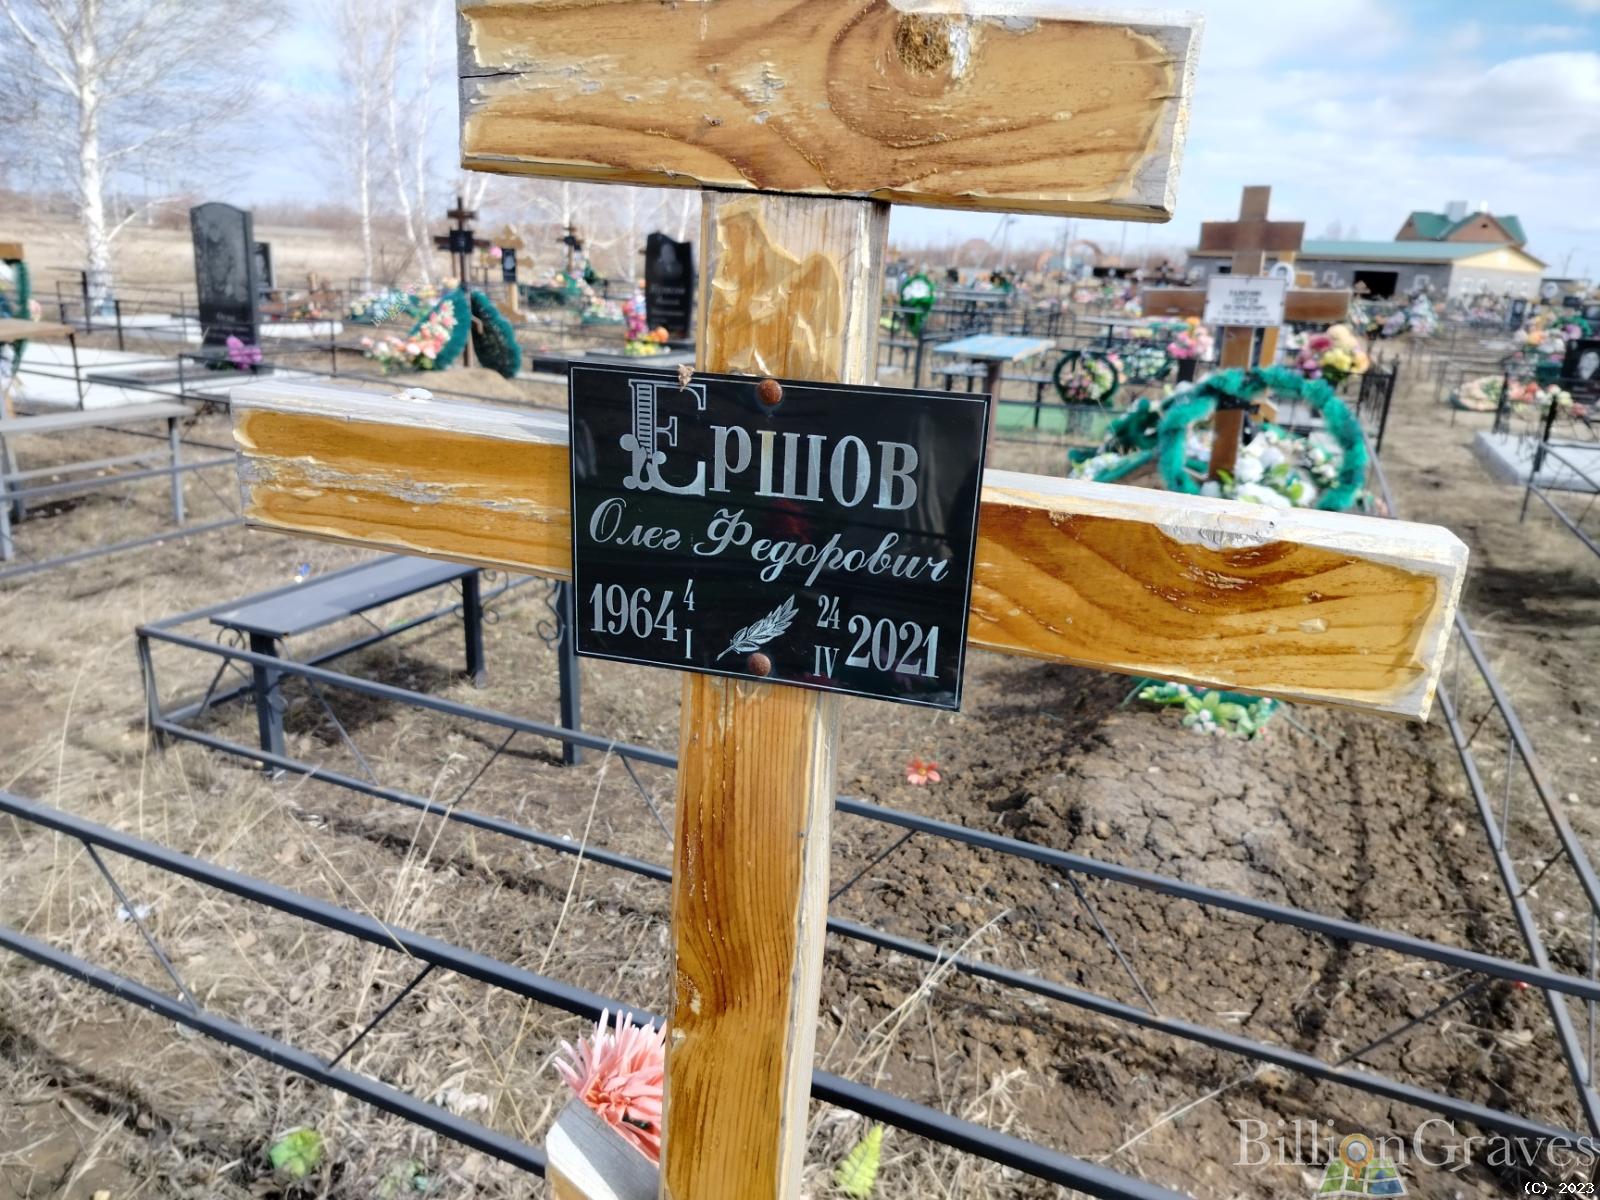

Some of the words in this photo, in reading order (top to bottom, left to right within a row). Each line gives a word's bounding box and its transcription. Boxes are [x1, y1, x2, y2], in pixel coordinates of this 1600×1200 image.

[589, 497, 682, 551] Олег
[693, 508, 949, 587] Федорович
[588, 583, 678, 642] 1964
[683, 579, 695, 611] 4
[817, 594, 840, 630] 24
[845, 614, 941, 679] 2021
[813, 645, 840, 679] IV
